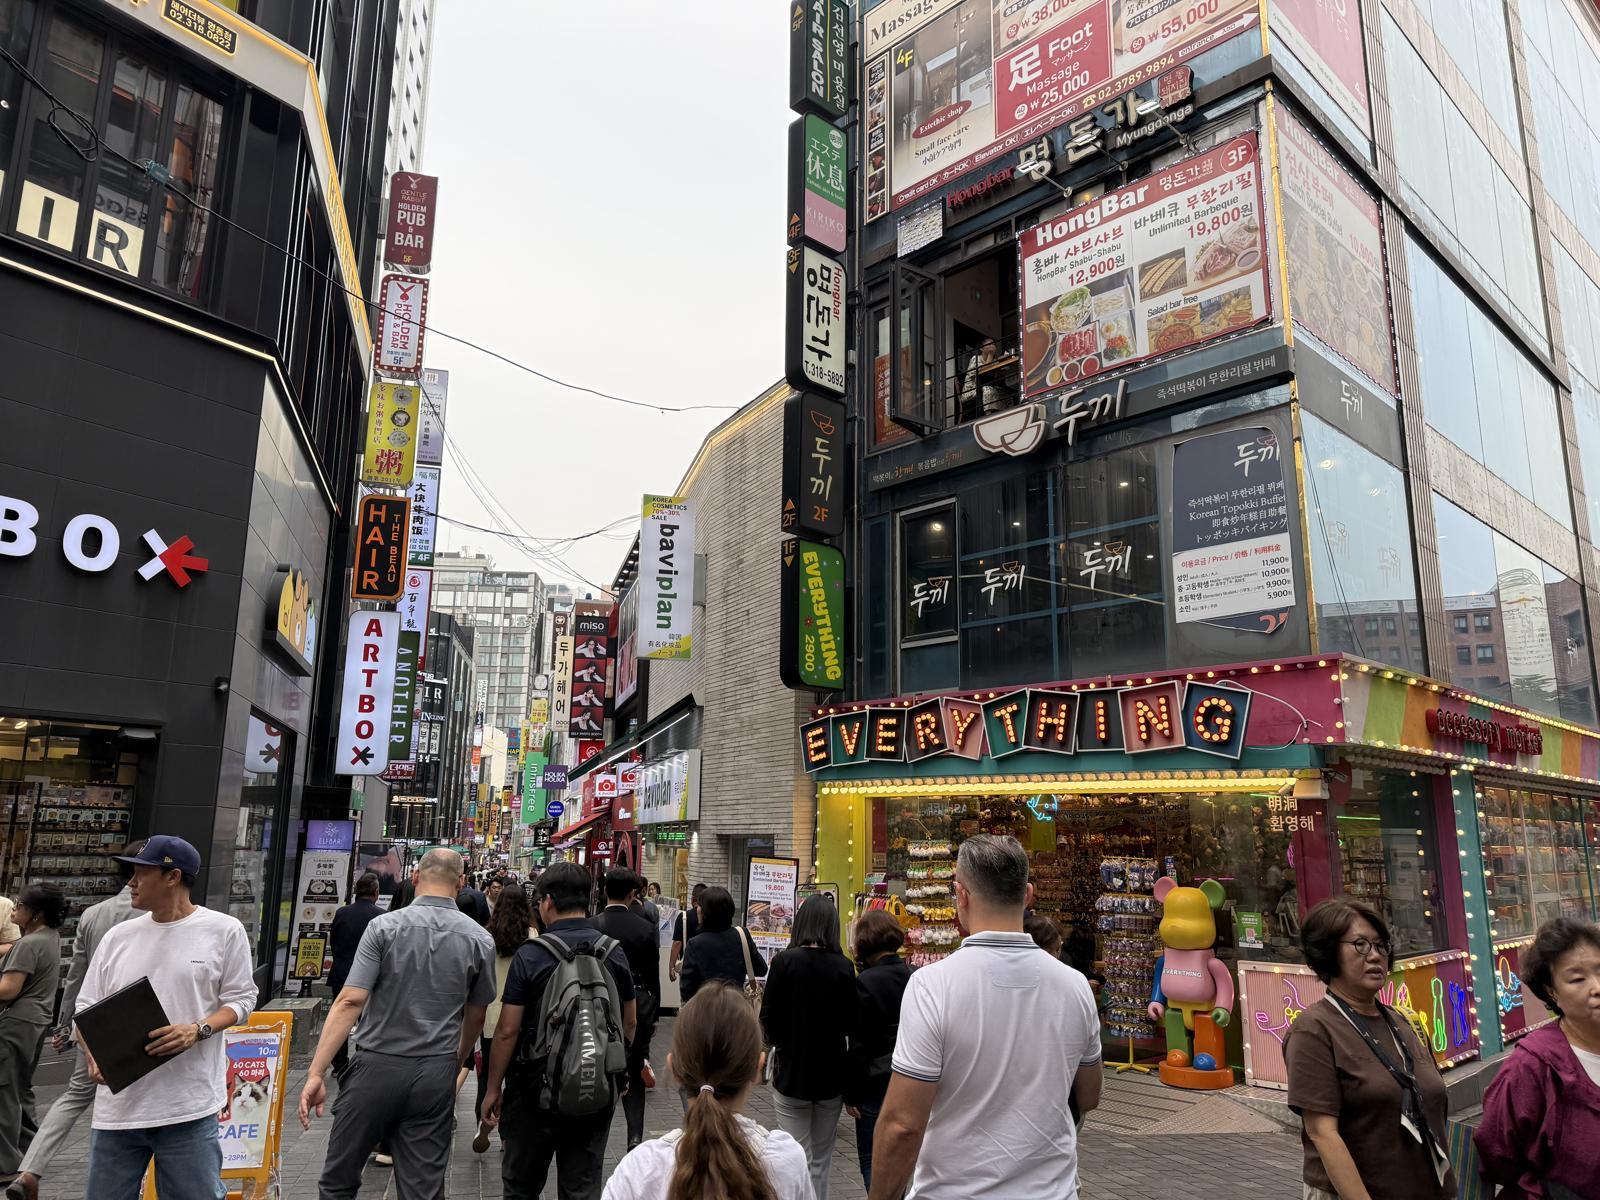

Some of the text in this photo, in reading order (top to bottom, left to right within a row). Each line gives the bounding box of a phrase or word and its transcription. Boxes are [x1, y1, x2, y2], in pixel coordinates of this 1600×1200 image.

[169, 9, 231, 49] 02.318.0822
[792, 14, 804, 31] 5F
[1048, 22, 1093, 59] Foot
[896, 49, 913, 67] 4F
[1179, 34, 1215, 57] entrance
[811, 38, 825, 98] SALON
[1008, 43, 1043, 92] 足
[1026, 62, 1080, 98] Massage
[1098, 54, 1175, 101] 02.3789.9894
[919, 105, 963, 134] Estethic shop
[1116, 103, 1193, 148] Myungdonga
[811, 137, 841, 160] エステ
[914, 124, 970, 159] Small face care
[974, 135, 1019, 163] Elevator OK!
[1227, 145, 1247, 167] 3F
[807, 150, 845, 192] 休息
[915, 182, 929, 194] card
[929, 177, 939, 187] OK
[945, 165, 1016, 209] Hongbar
[1159, 164, 1201, 191] 명돈가
[396, 210, 426, 226] PUB
[397, 202, 427, 213] HOLDEM
[1036, 183, 1149, 247] HongBar
[1133, 170, 1253, 230] 바베큐 무한리필
[1149, 195, 1239, 238] Unlimited Barbeque
[789, 226, 801, 238] 4F
[806, 206, 844, 233] KIRIKO
[1187, 202, 1253, 239] 19,800원
[394, 231, 424, 248] BAR
[788, 249, 801, 263] 3F
[1033, 224, 1125, 275] 홍빠 샤브샤브
[1036, 243, 1121, 283] HongBar Shabu-Shabu
[1068, 253, 1125, 286] 12,900원
[394, 302, 403, 320] PUB
[832, 266, 843, 321] Hongbar
[1147, 295, 1198, 318] Salad bar free
[391, 331, 400, 348] BAR
[399, 303, 412, 350] HOLDEM
[393, 356, 404, 364] 5F
[804, 360, 844, 387] T.318-5892
[1156, 354, 1276, 400] 즉석떡볶이 무한리필 뷔페
[1053, 378, 1127, 447] 두끼
[1341, 380, 1363, 421] 두끼
[1233, 440, 1280, 477] 두끼
[652, 503, 688, 511] COSMETICS
[783, 513, 796, 527] 2F
[813, 505, 829, 522] 2F
[1189, 507, 1220, 521] Korean
[1221, 497, 1259, 515] Topokki
[362, 504, 387, 590] HAIR
[387, 514, 401, 583] THE BEAU
[783, 540, 797, 554] 1F
[1181, 557, 1206, 569] 이용요금
[1212, 554, 1229, 564] Price
[656, 523, 680, 630] baviplan
[981, 565, 1025, 606] 두끼
[1080, 545, 1132, 589] 두끼
[803, 551, 842, 681] EVERYTHING
[910, 580, 949, 618] 두끼
[579, 621, 605, 631] miso
[805, 634, 815, 672] 2900
[389, 647, 413, 744] ANOTHER
[807, 694, 1233, 764] EVERYTHING
[527, 763, 539, 812] innisfree
[643, 773, 671, 812] baviplan
[233, 1060, 265, 1069] 60 CATS
